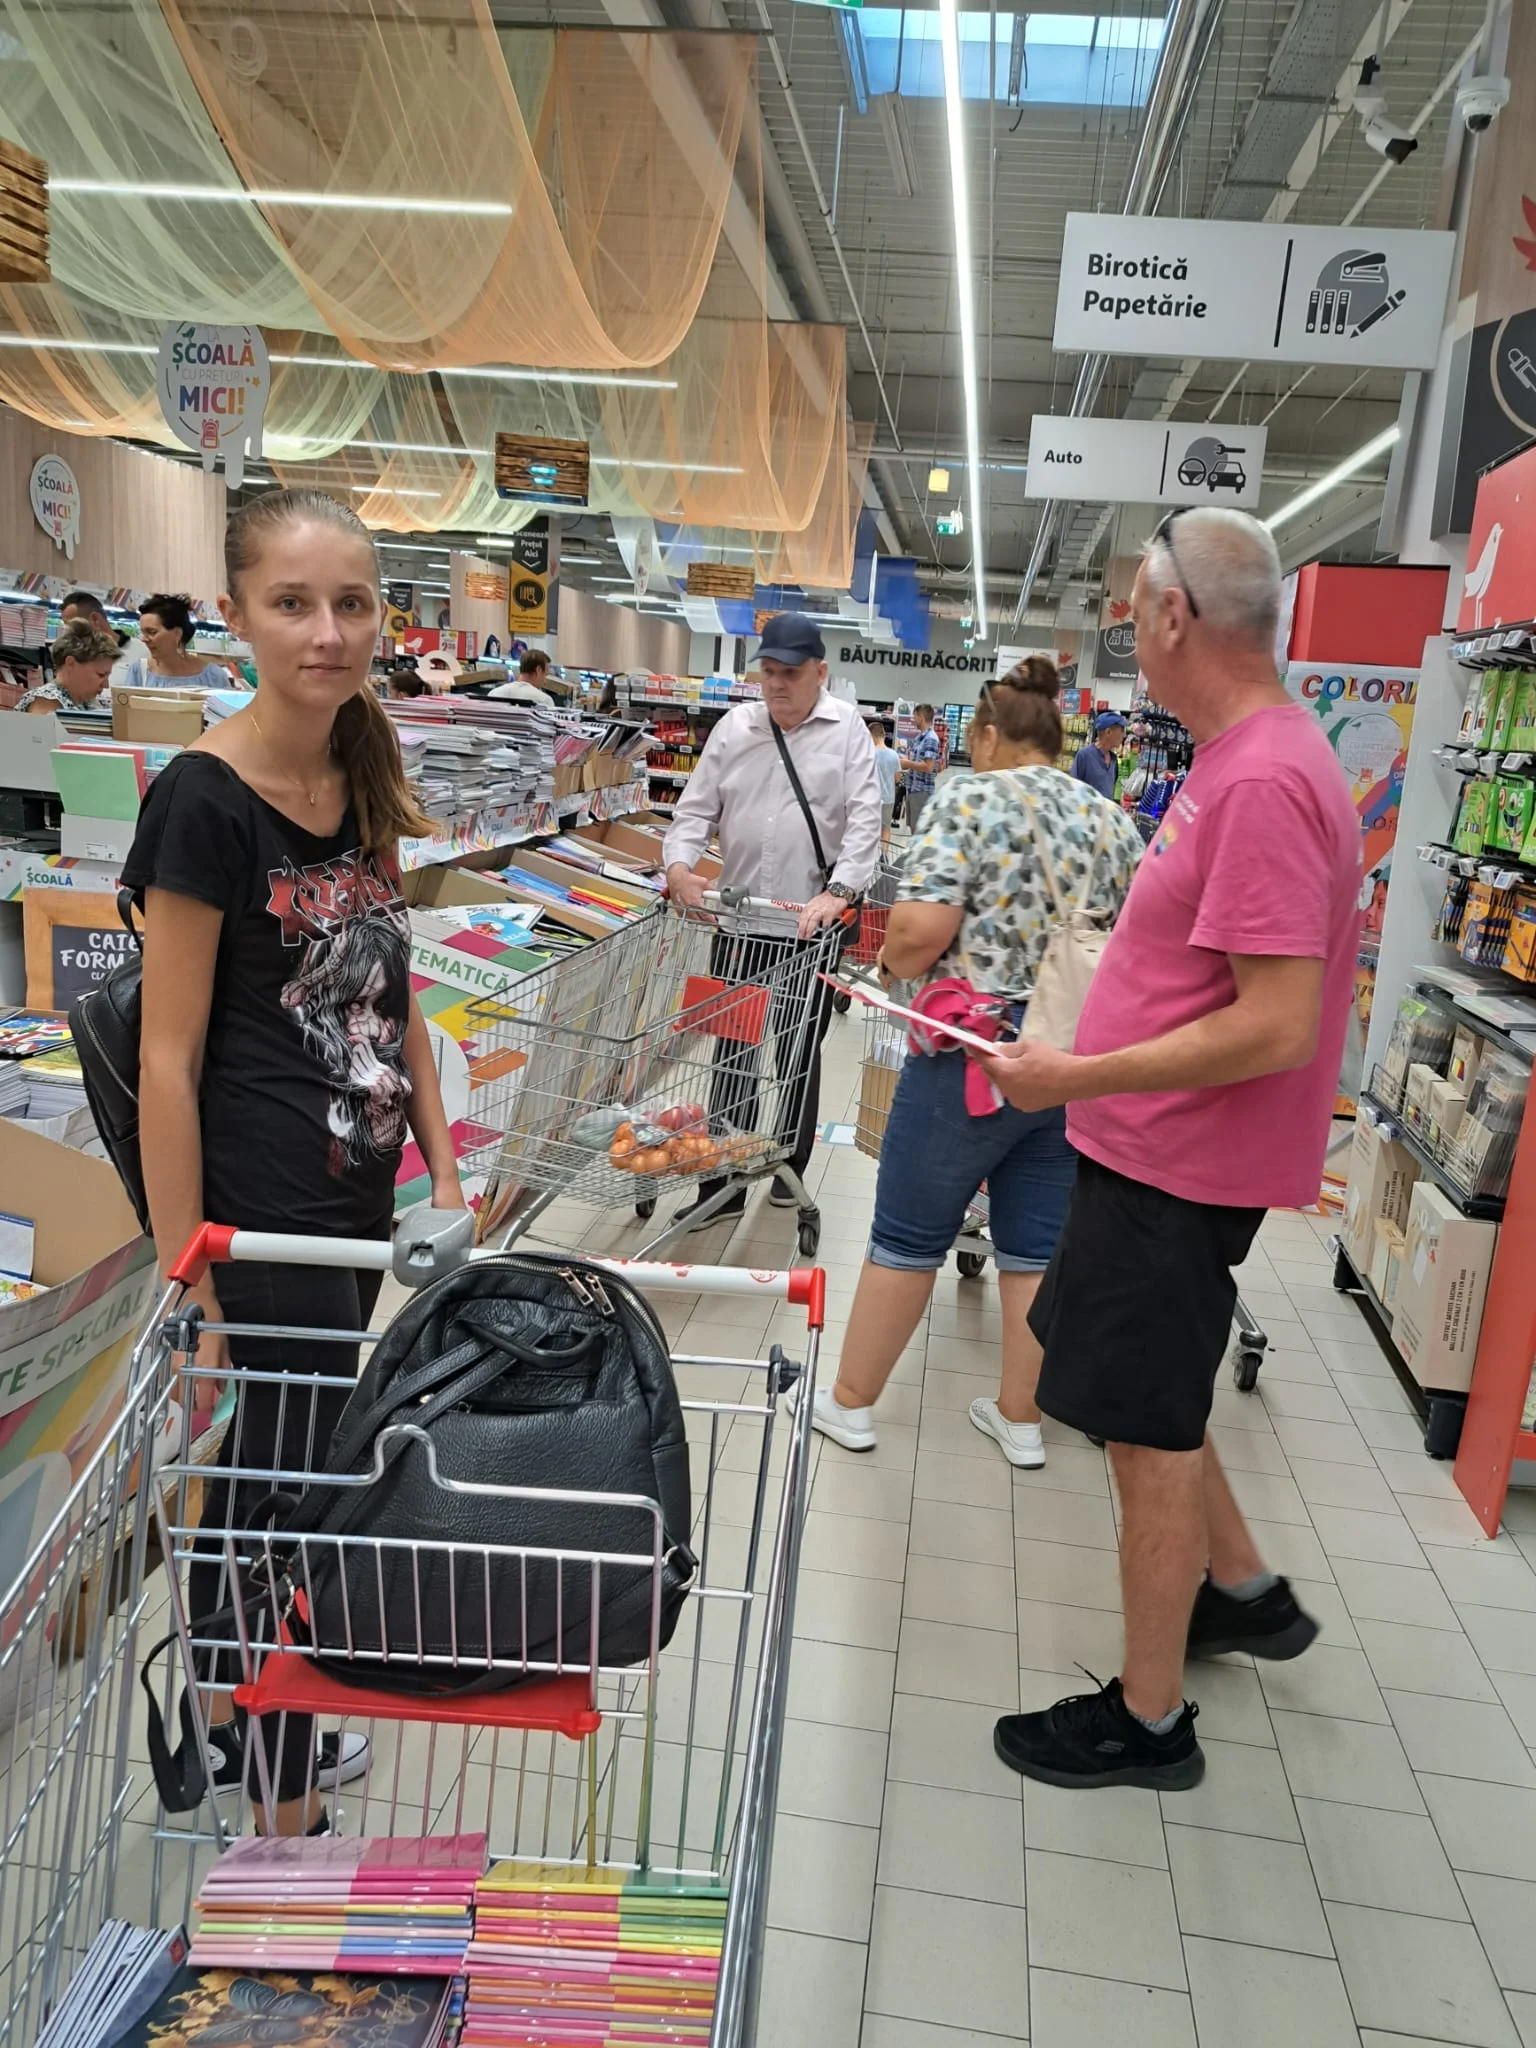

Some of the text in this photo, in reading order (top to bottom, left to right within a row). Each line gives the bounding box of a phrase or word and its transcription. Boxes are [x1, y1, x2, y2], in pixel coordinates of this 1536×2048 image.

[1087, 252, 1188, 281] Birotică
[1083, 290, 1207, 319] Papetărie
[172, 339, 254, 372] ȘCOALĂ
[179, 384, 245, 416] MICI!
[1044, 448, 1082, 465] Auto
[42, 499, 71, 520] MICI!
[840, 644, 917, 667] BĂUTURI
[27, 872, 73, 886] ȘCOALĂ
[88, 933, 144, 952] CAIE
